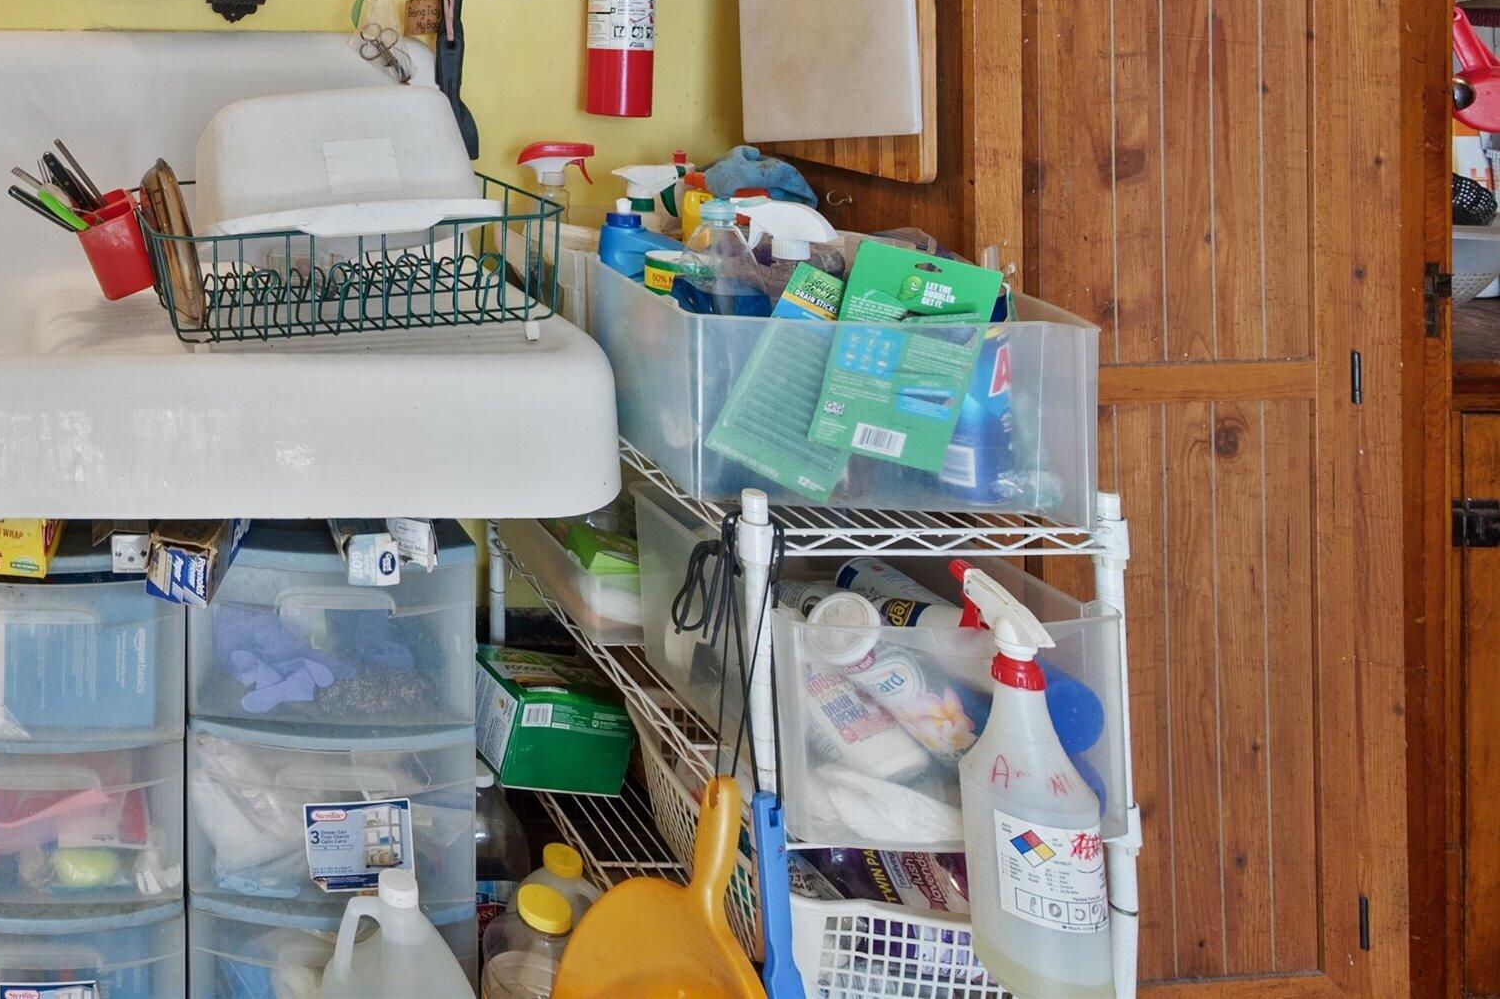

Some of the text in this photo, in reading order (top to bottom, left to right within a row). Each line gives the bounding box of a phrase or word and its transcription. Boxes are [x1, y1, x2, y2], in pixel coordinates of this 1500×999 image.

[925, 281, 953, 295] LET THE
[794, 288, 816, 304] DRAIN
[815, 299, 839, 314] STICKS
[921, 297, 934, 307] GET
[923, 290, 956, 304] GOBBLER
[3, 528, 24, 540] WRAP
[172, 555, 184, 582] Paper
[195, 555, 206, 599] Reynolds
[315, 812, 344, 820] Sterilite
[310, 830, 320, 845] 3
[902, 856, 925, 886] lush
[870, 866, 898, 904] TWIN
